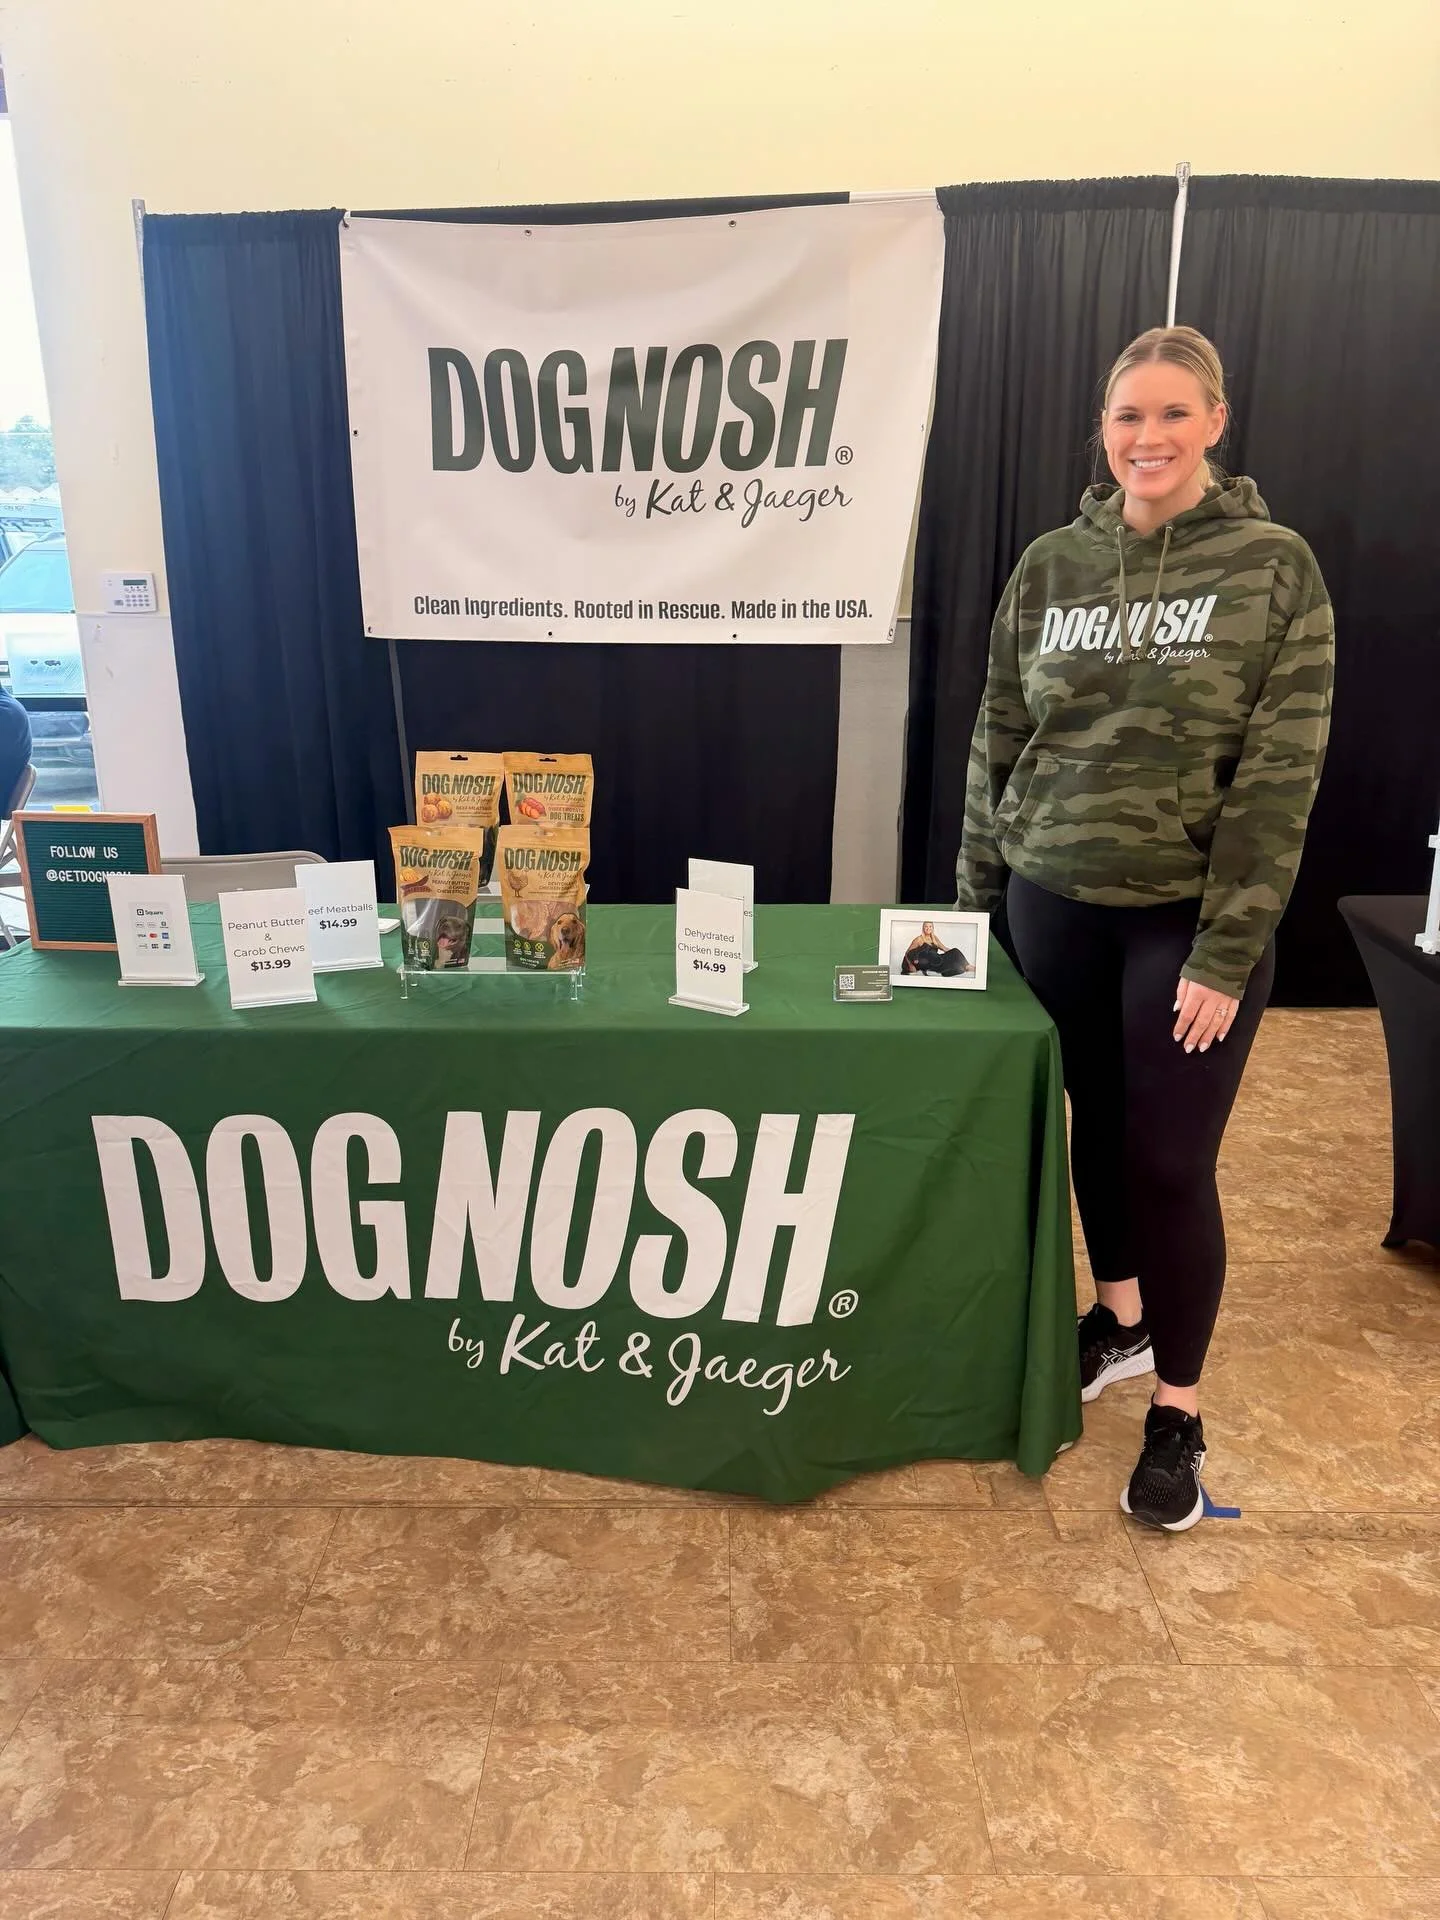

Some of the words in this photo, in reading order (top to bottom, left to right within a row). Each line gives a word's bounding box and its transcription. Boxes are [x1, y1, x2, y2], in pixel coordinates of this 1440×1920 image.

[615, 484, 636, 517] by
[646, 478, 706, 519] Kat
[714, 482, 735, 511] &
[741, 478, 853, 528] Jaeger
[414, 595, 460, 615] Clean
[465, 597, 568, 619] Ingredients.
[574, 600, 633, 619] Rooted
[638, 600, 653, 619] in
[658, 601, 725, 620] Rescue.
[731, 600, 776, 619] Made
[781, 598, 797, 619] in
[802, 599, 830, 619] the
[835, 599, 873, 619] USA.
[1104, 652, 1114, 664] by
[1147, 647, 1158, 659] &
[1157, 645, 1211, 664] Jaeger
[50, 845, 96, 859] FOLLOW
[103, 846, 119, 859] US
[308, 905, 323, 916] eef
[326, 903, 373, 915] Meatballs
[228, 919, 268, 931] Peanut
[271, 917, 305, 928] Butter
[319, 917, 358, 930] $14.99
[264, 932, 272, 942] &
[684, 927, 735, 943] Dehydrated
[233, 945, 266, 958] Carob
[269, 943, 305, 955] Chews
[678, 942, 712, 955] Chicken
[714, 947, 742, 960] Breast
[250, 959, 292, 972] $13.99
[693, 959, 726, 973] $14.99
[448, 1318, 484, 1369] by
[500, 1313, 605, 1375] Kat
[618, 1332, 653, 1378] &
[666, 1332, 852, 1416] Jaeger
